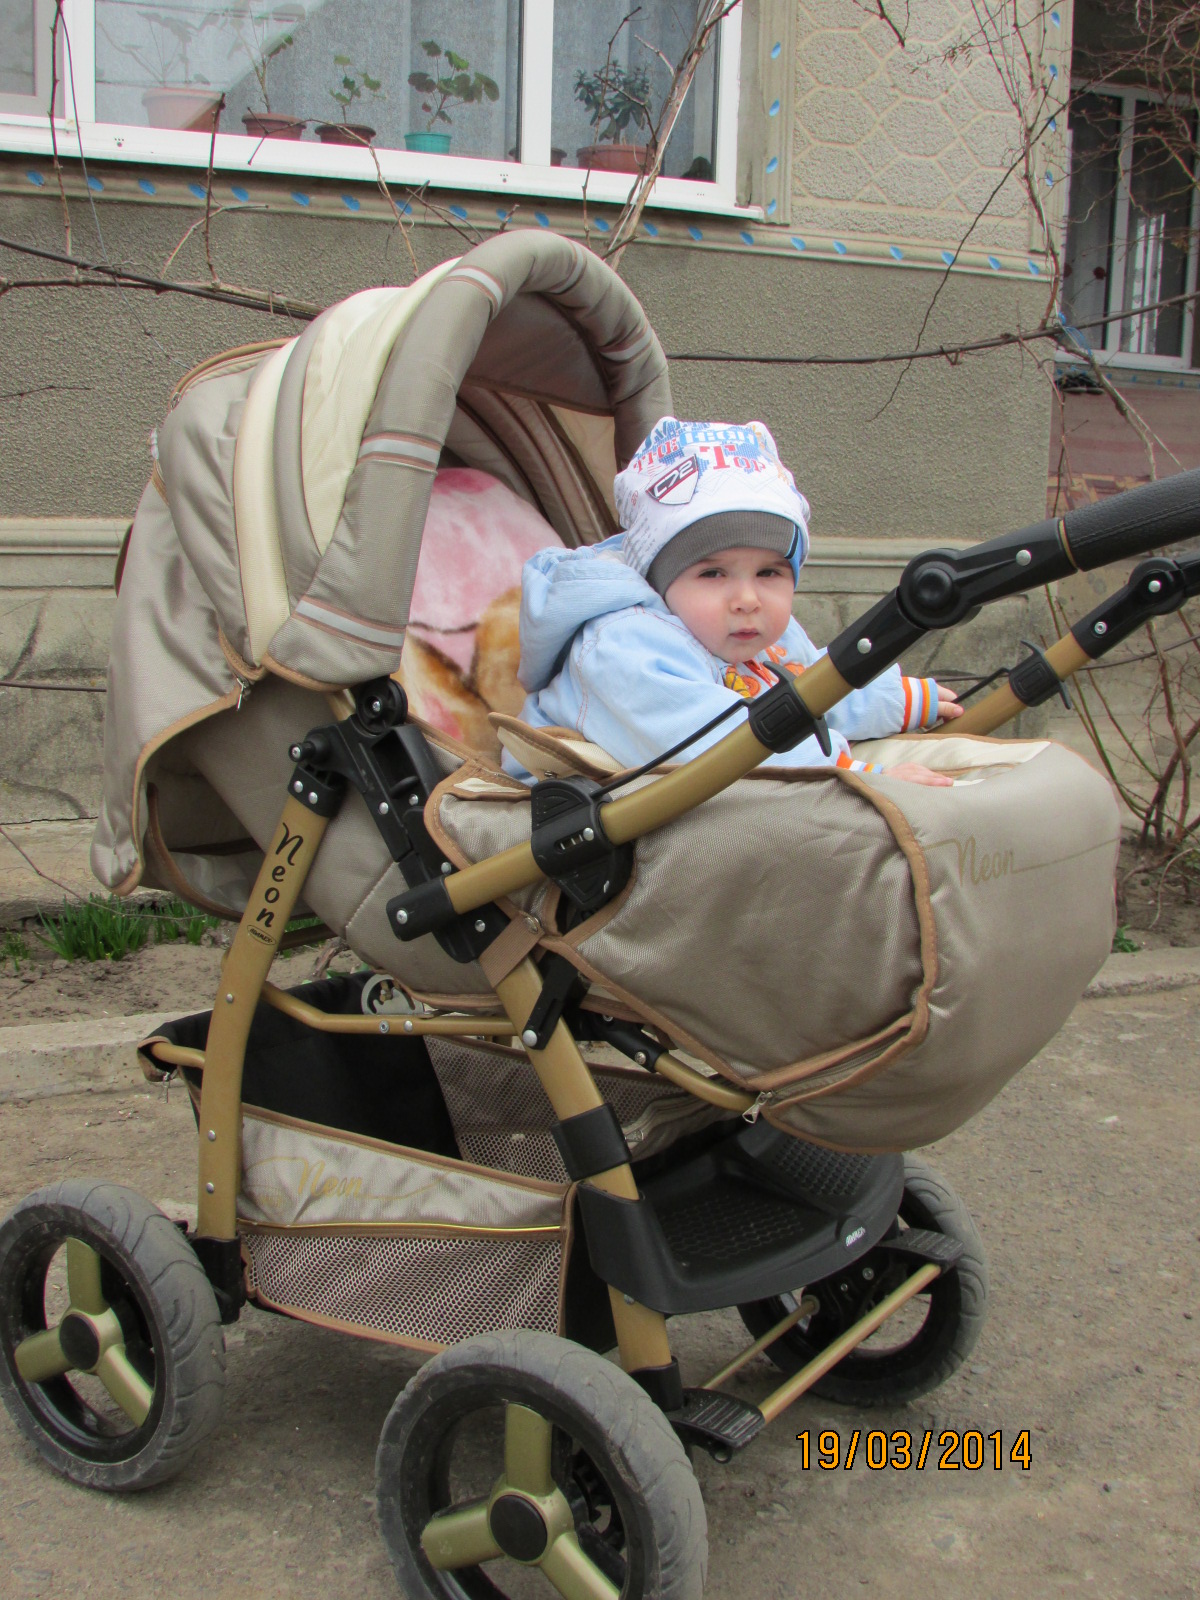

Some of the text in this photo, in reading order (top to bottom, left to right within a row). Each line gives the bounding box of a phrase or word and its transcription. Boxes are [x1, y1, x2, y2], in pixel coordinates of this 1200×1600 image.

[256, 822, 304, 928] Neon
[954, 834, 1016, 886] Neon
[297, 1159, 363, 1198] Neon
